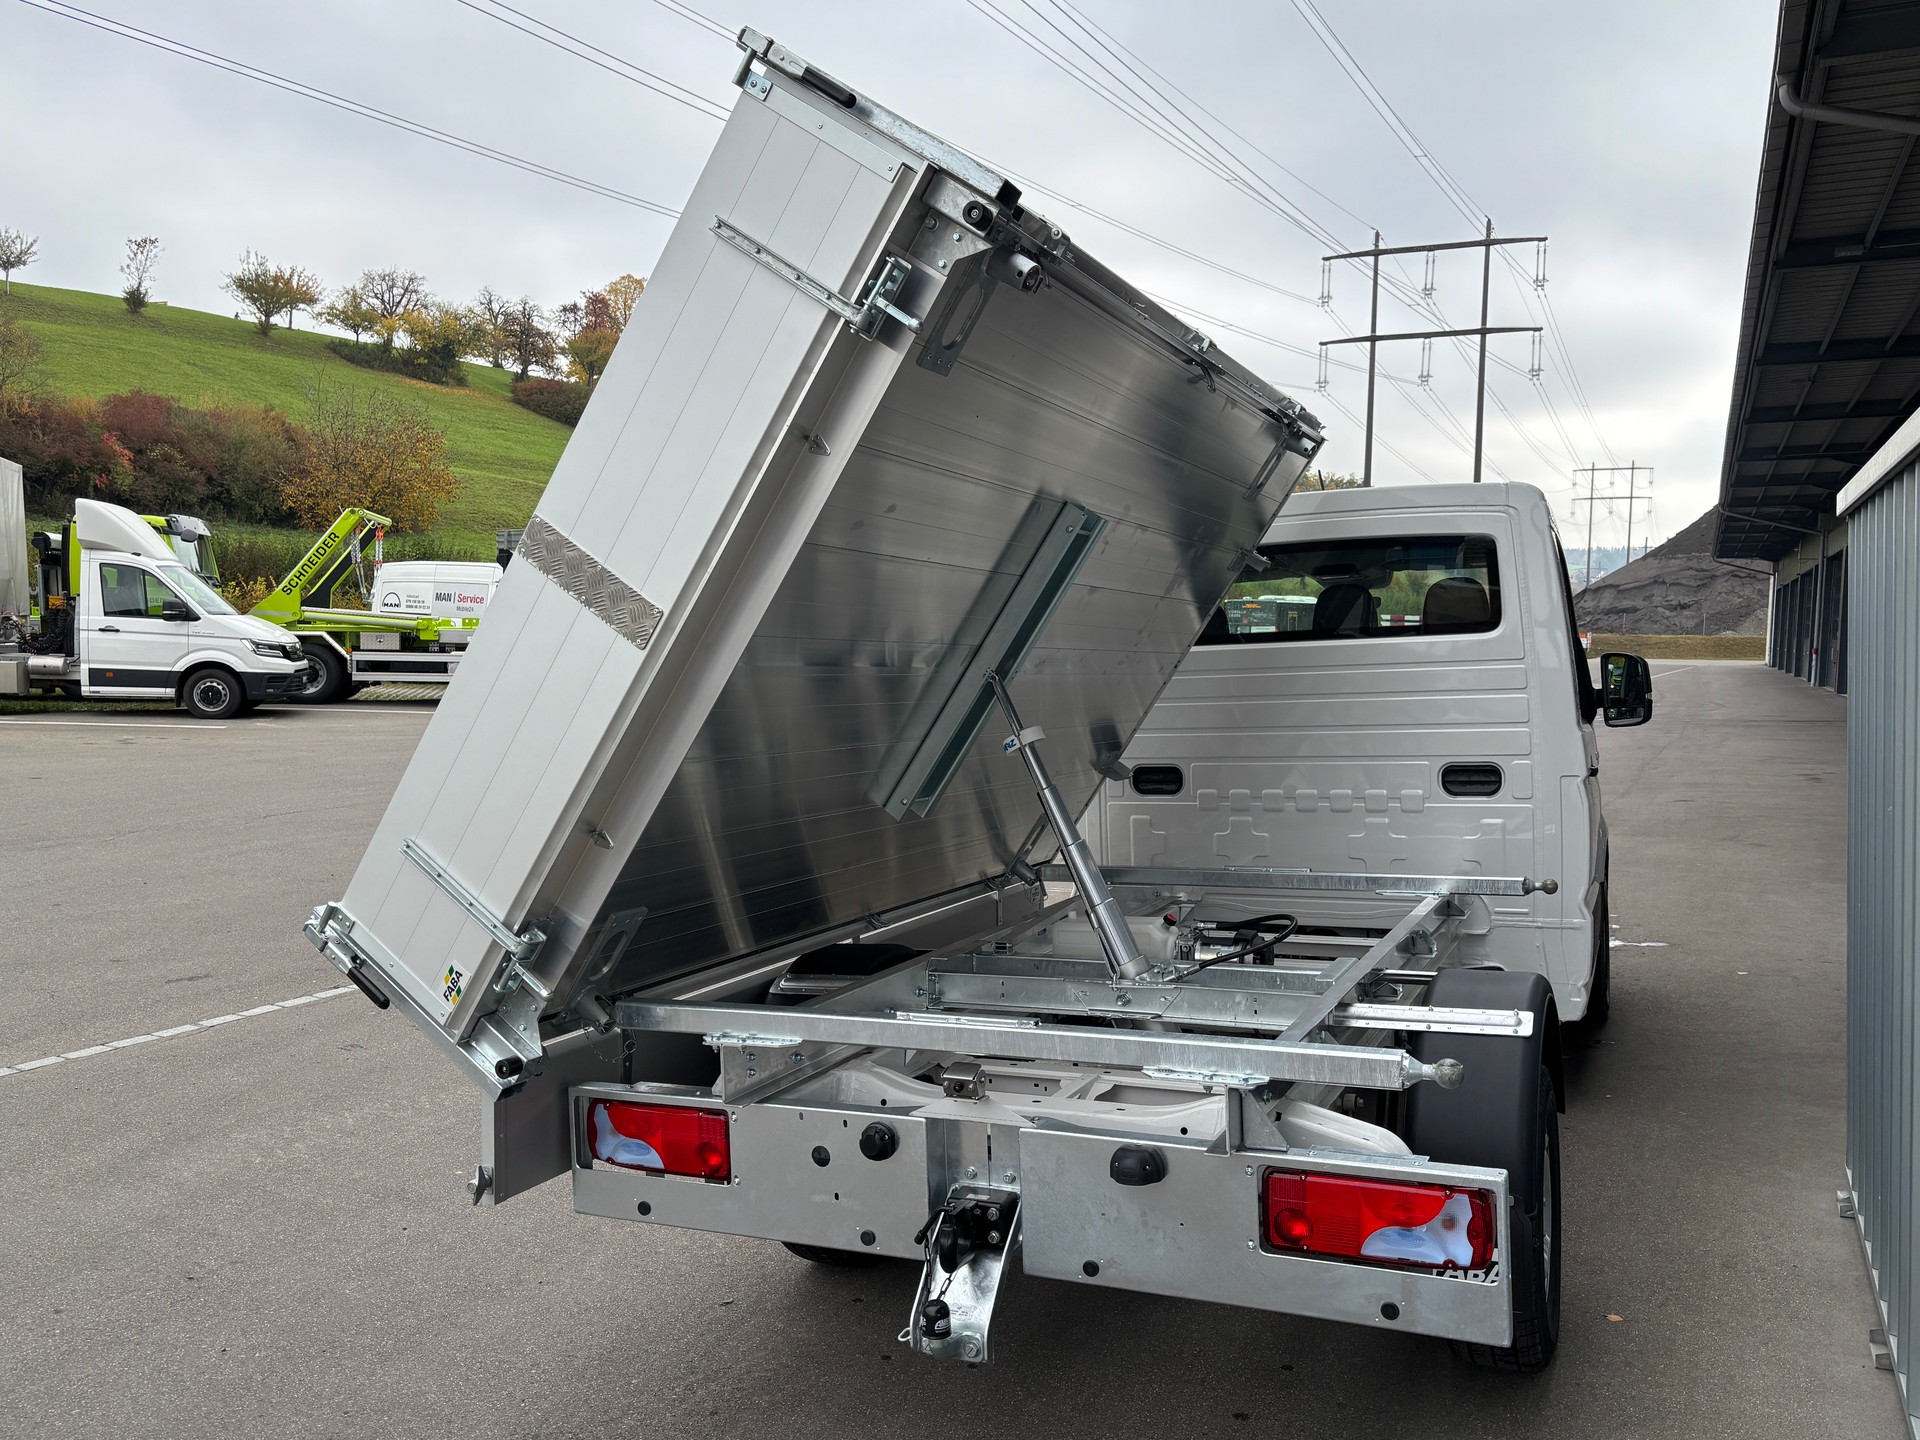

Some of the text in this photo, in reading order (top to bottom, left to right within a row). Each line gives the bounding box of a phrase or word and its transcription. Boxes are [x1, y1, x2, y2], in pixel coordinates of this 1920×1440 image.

[281, 531, 340, 596] SCHNEIDER
[435, 592, 452, 602] MAN
[457, 593, 485, 604] Service
[443, 970, 463, 1002] FABA
